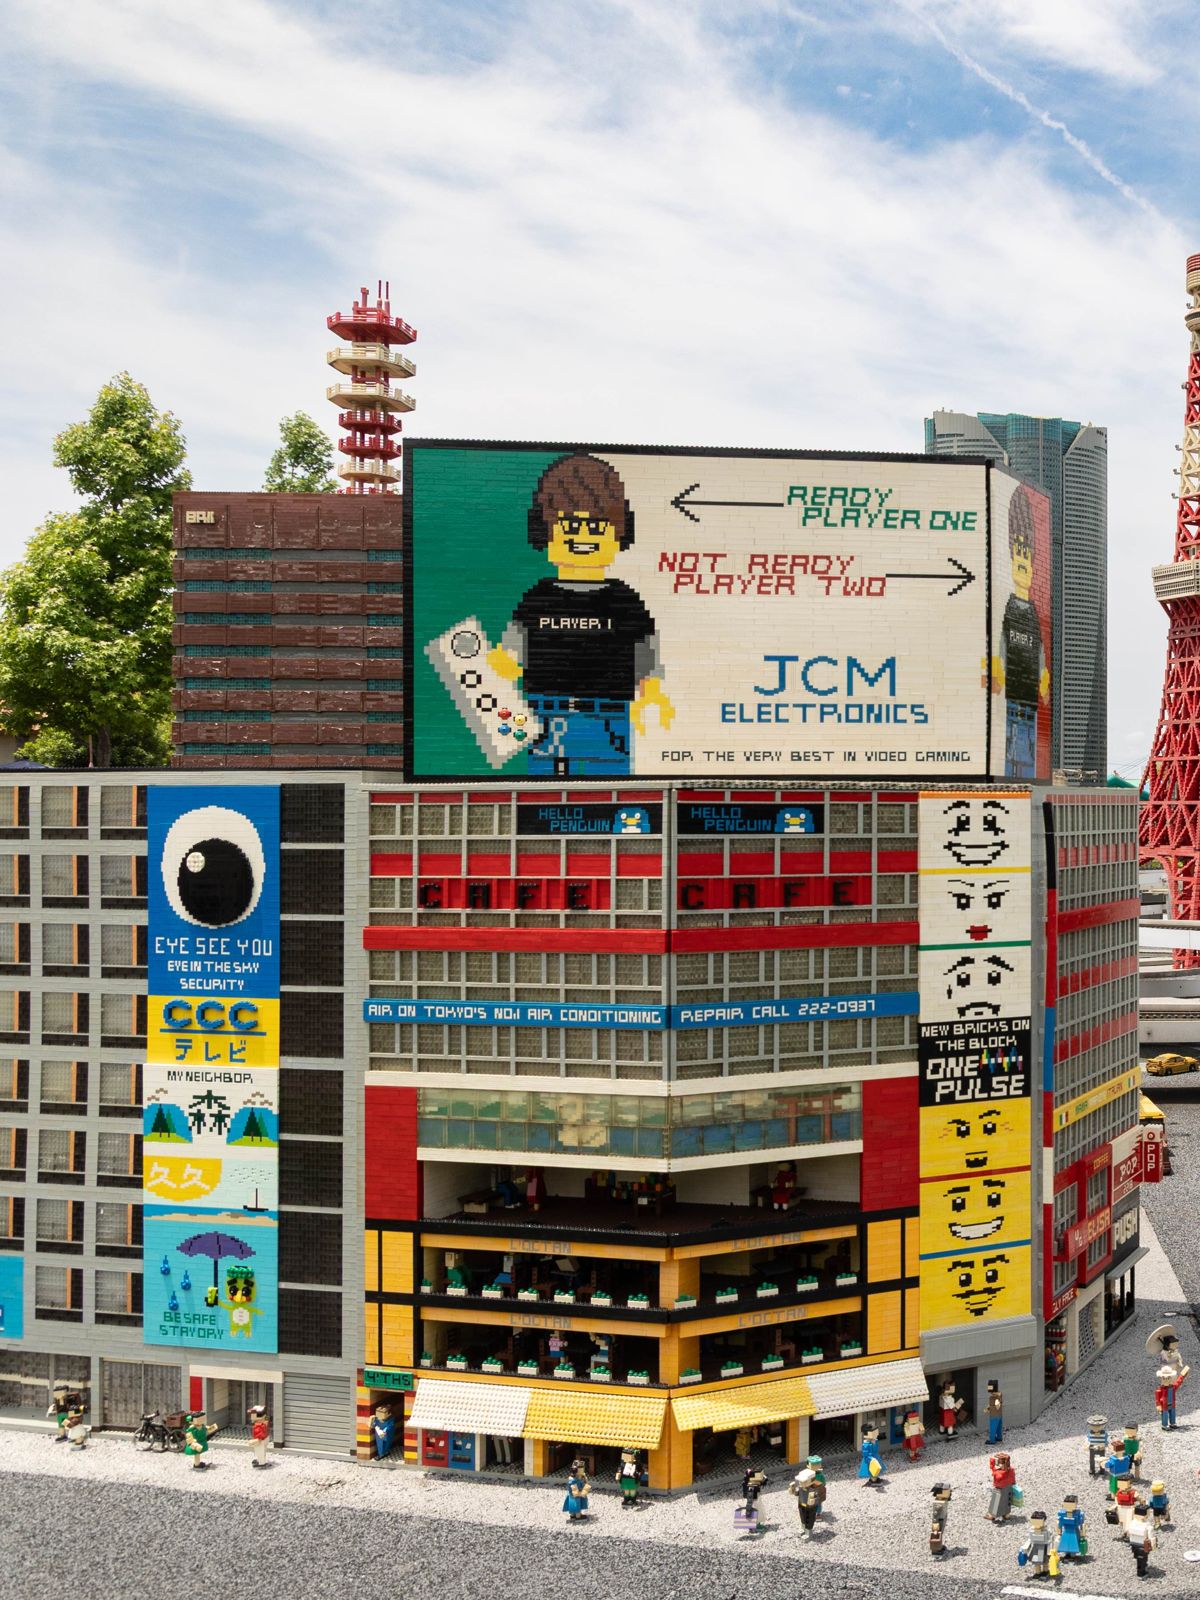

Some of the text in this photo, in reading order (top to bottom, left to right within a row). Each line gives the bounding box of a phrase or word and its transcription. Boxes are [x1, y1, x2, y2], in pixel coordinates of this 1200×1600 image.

[787, 485, 893, 507] READY
[802, 507, 977, 531] PLAYER ONE
[658, 552, 855, 576] NOT READY
[673, 574, 888, 597] PLAYER TWO
[539, 617, 600, 629] PLAYER
[1009, 630, 1029, 646] PLAYER
[753, 655, 897, 697] JCM
[720, 702, 929, 724] ELECTRONICS
[661, 750, 971, 763] FOR THE VERY BEST IN VIDEO GAMING
[539, 808, 583, 820] HELLO
[691, 807, 741, 819] HELLO
[550, 820, 610, 832] PENGUIN
[704, 819, 771, 831] PENGUIN
[420, 883, 590, 909] CAFE
[682, 881, 853, 910] CAFE
[155, 937, 272, 956] EYE SEE YOU
[168, 960, 260, 974] EYE IN THE SKY
[180, 978, 244, 991] SECURITY
[163, 1000, 257, 1030] CCC
[369, 1005, 392, 1016] AIR
[398, 1005, 416, 1017] ON
[424, 1006, 487, 1019] TOKYO'S
[528, 1008, 552, 1020] AIR
[560, 1009, 661, 1023] CONDITIONING
[681, 1000, 875, 1022] REPAIR CALL 222-0937
[921, 1020, 1030, 1037] NEW BRICKS ON
[175, 1038, 246, 1063] テレビ
[936, 1036, 1017, 1051] THE BLOCK
[167, 1071, 252, 1084] MY NEIGHBOR
[926, 1055, 980, 1080] ONE
[935, 1075, 1024, 1102] PULSE
[188, 1090, 231, 1135] 森
[1147, 1144, 1155, 1172] POP
[1120, 1156, 1138, 1182] POP
[1113, 1207, 1138, 1251] PUSH
[164, 1311, 216, 1325] BE SAFE
[160, 1324, 223, 1340] STAY DRY
[367, 1371, 411, 1386] 4'THS
